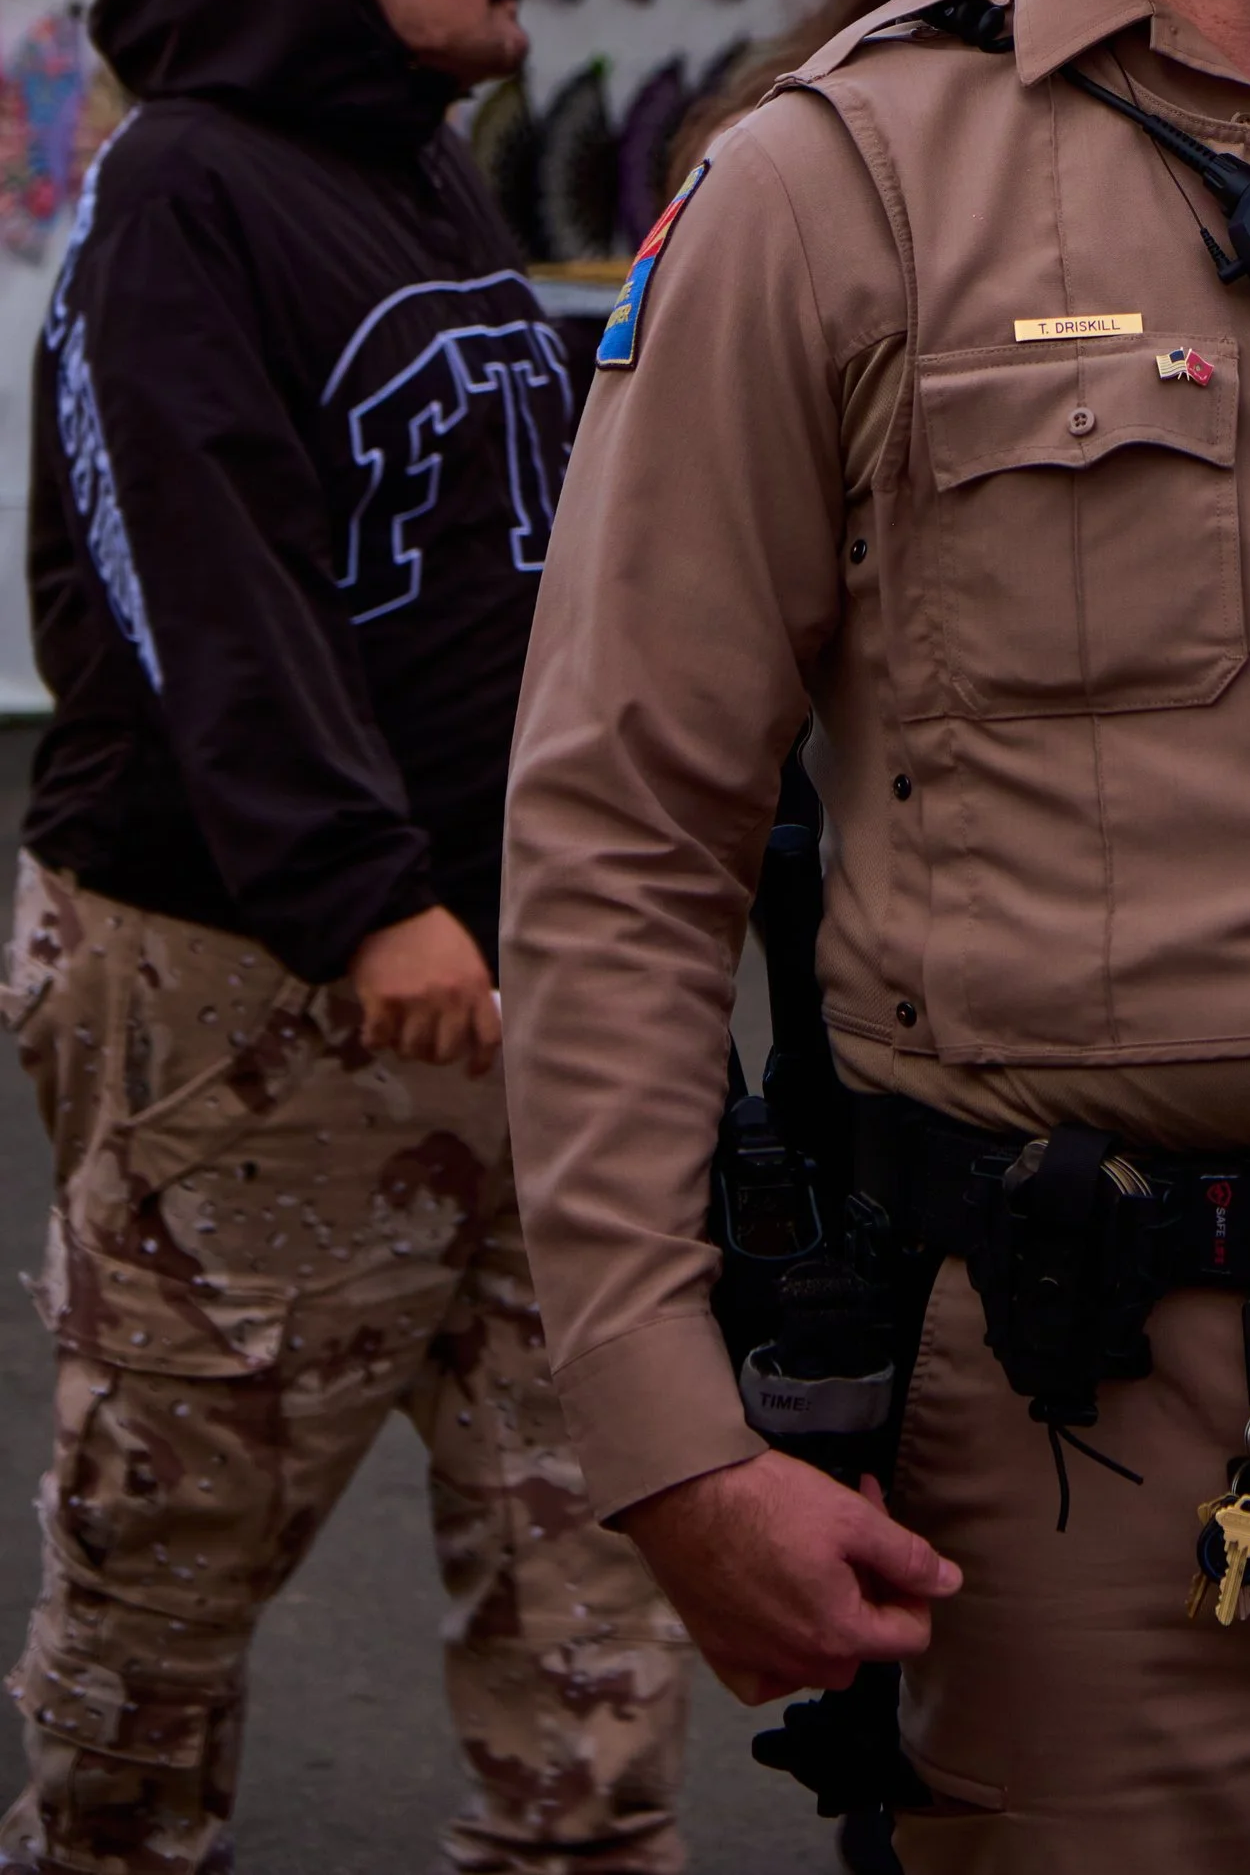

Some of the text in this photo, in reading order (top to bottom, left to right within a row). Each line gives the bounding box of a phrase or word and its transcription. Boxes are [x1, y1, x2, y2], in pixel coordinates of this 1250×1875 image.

[1038, 319, 1121, 335] T. DRISKILL
[335, 319, 575, 625] FT
[1215, 1207, 1226, 1238] SAFE
[760, 1392, 811, 1411] TIME:
